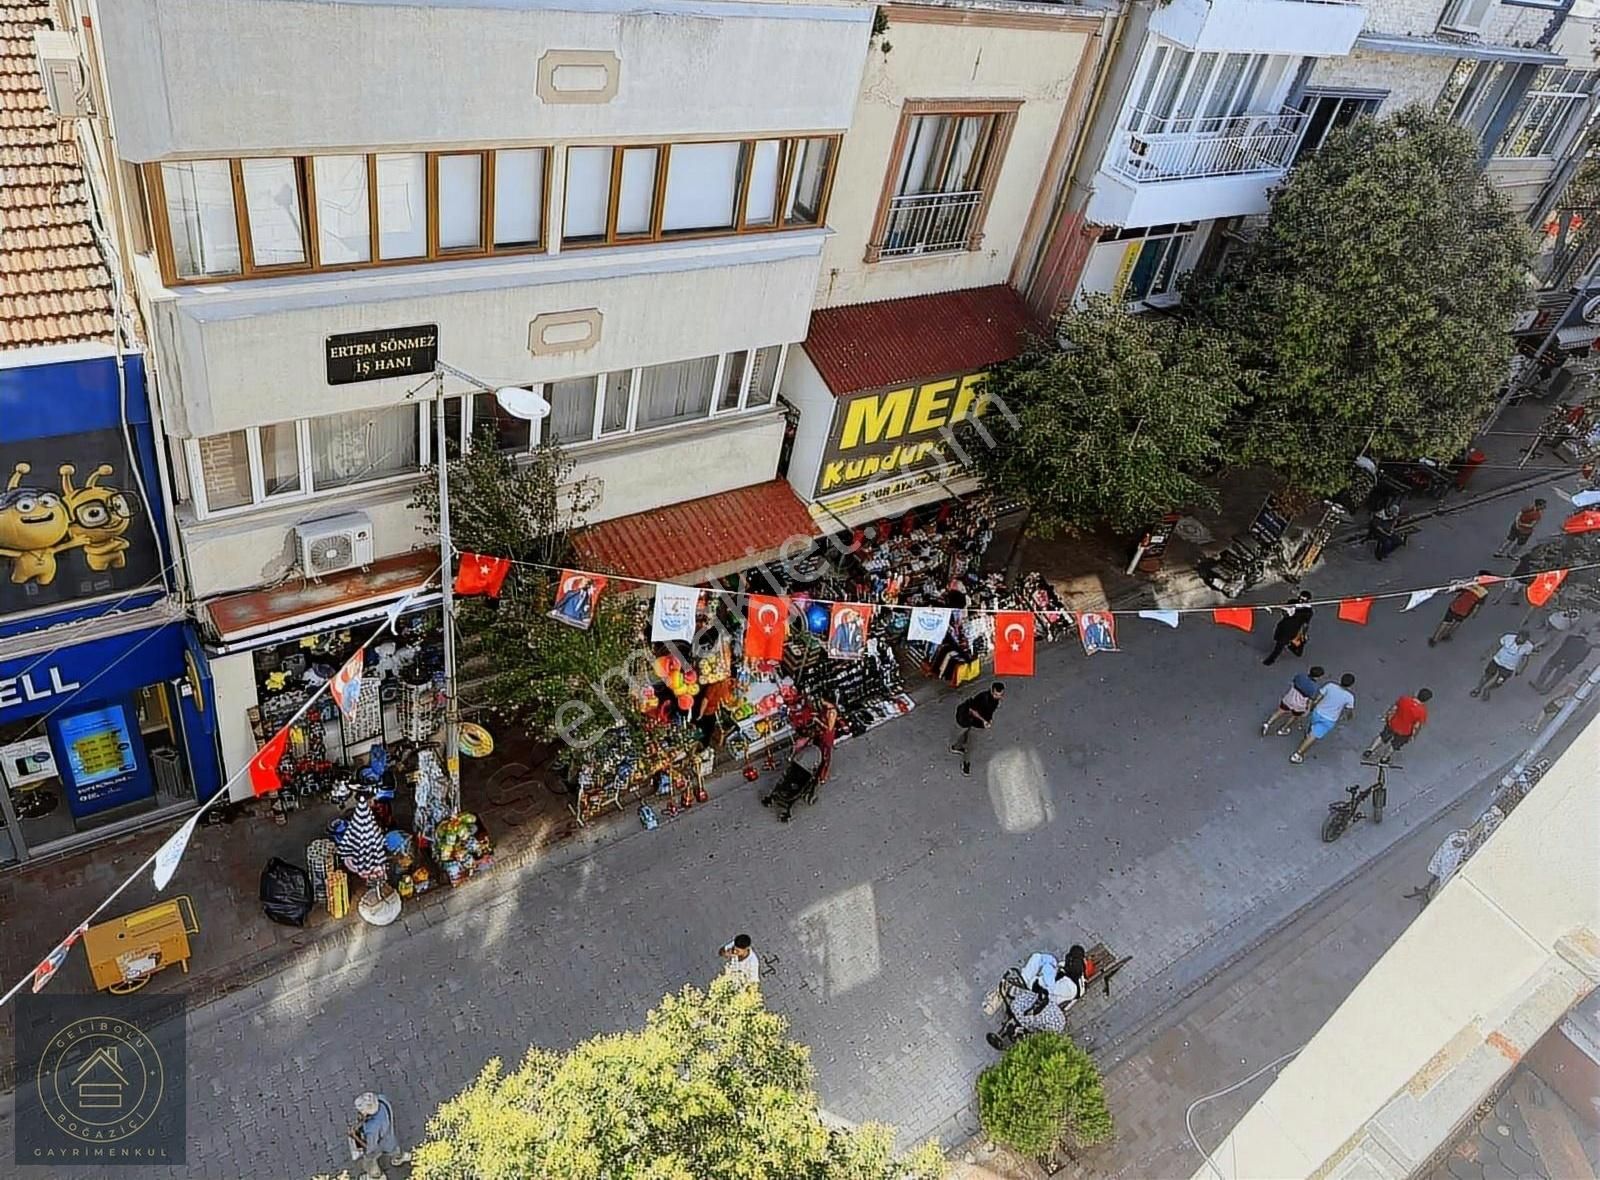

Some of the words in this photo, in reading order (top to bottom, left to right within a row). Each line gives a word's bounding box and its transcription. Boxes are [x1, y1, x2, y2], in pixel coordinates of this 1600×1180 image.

[330, 343, 377, 358] ERTEM
[380, 335, 436, 353] SÖNMEZ
[356, 358, 370, 374] İŞ
[375, 356, 412, 371] HANI
